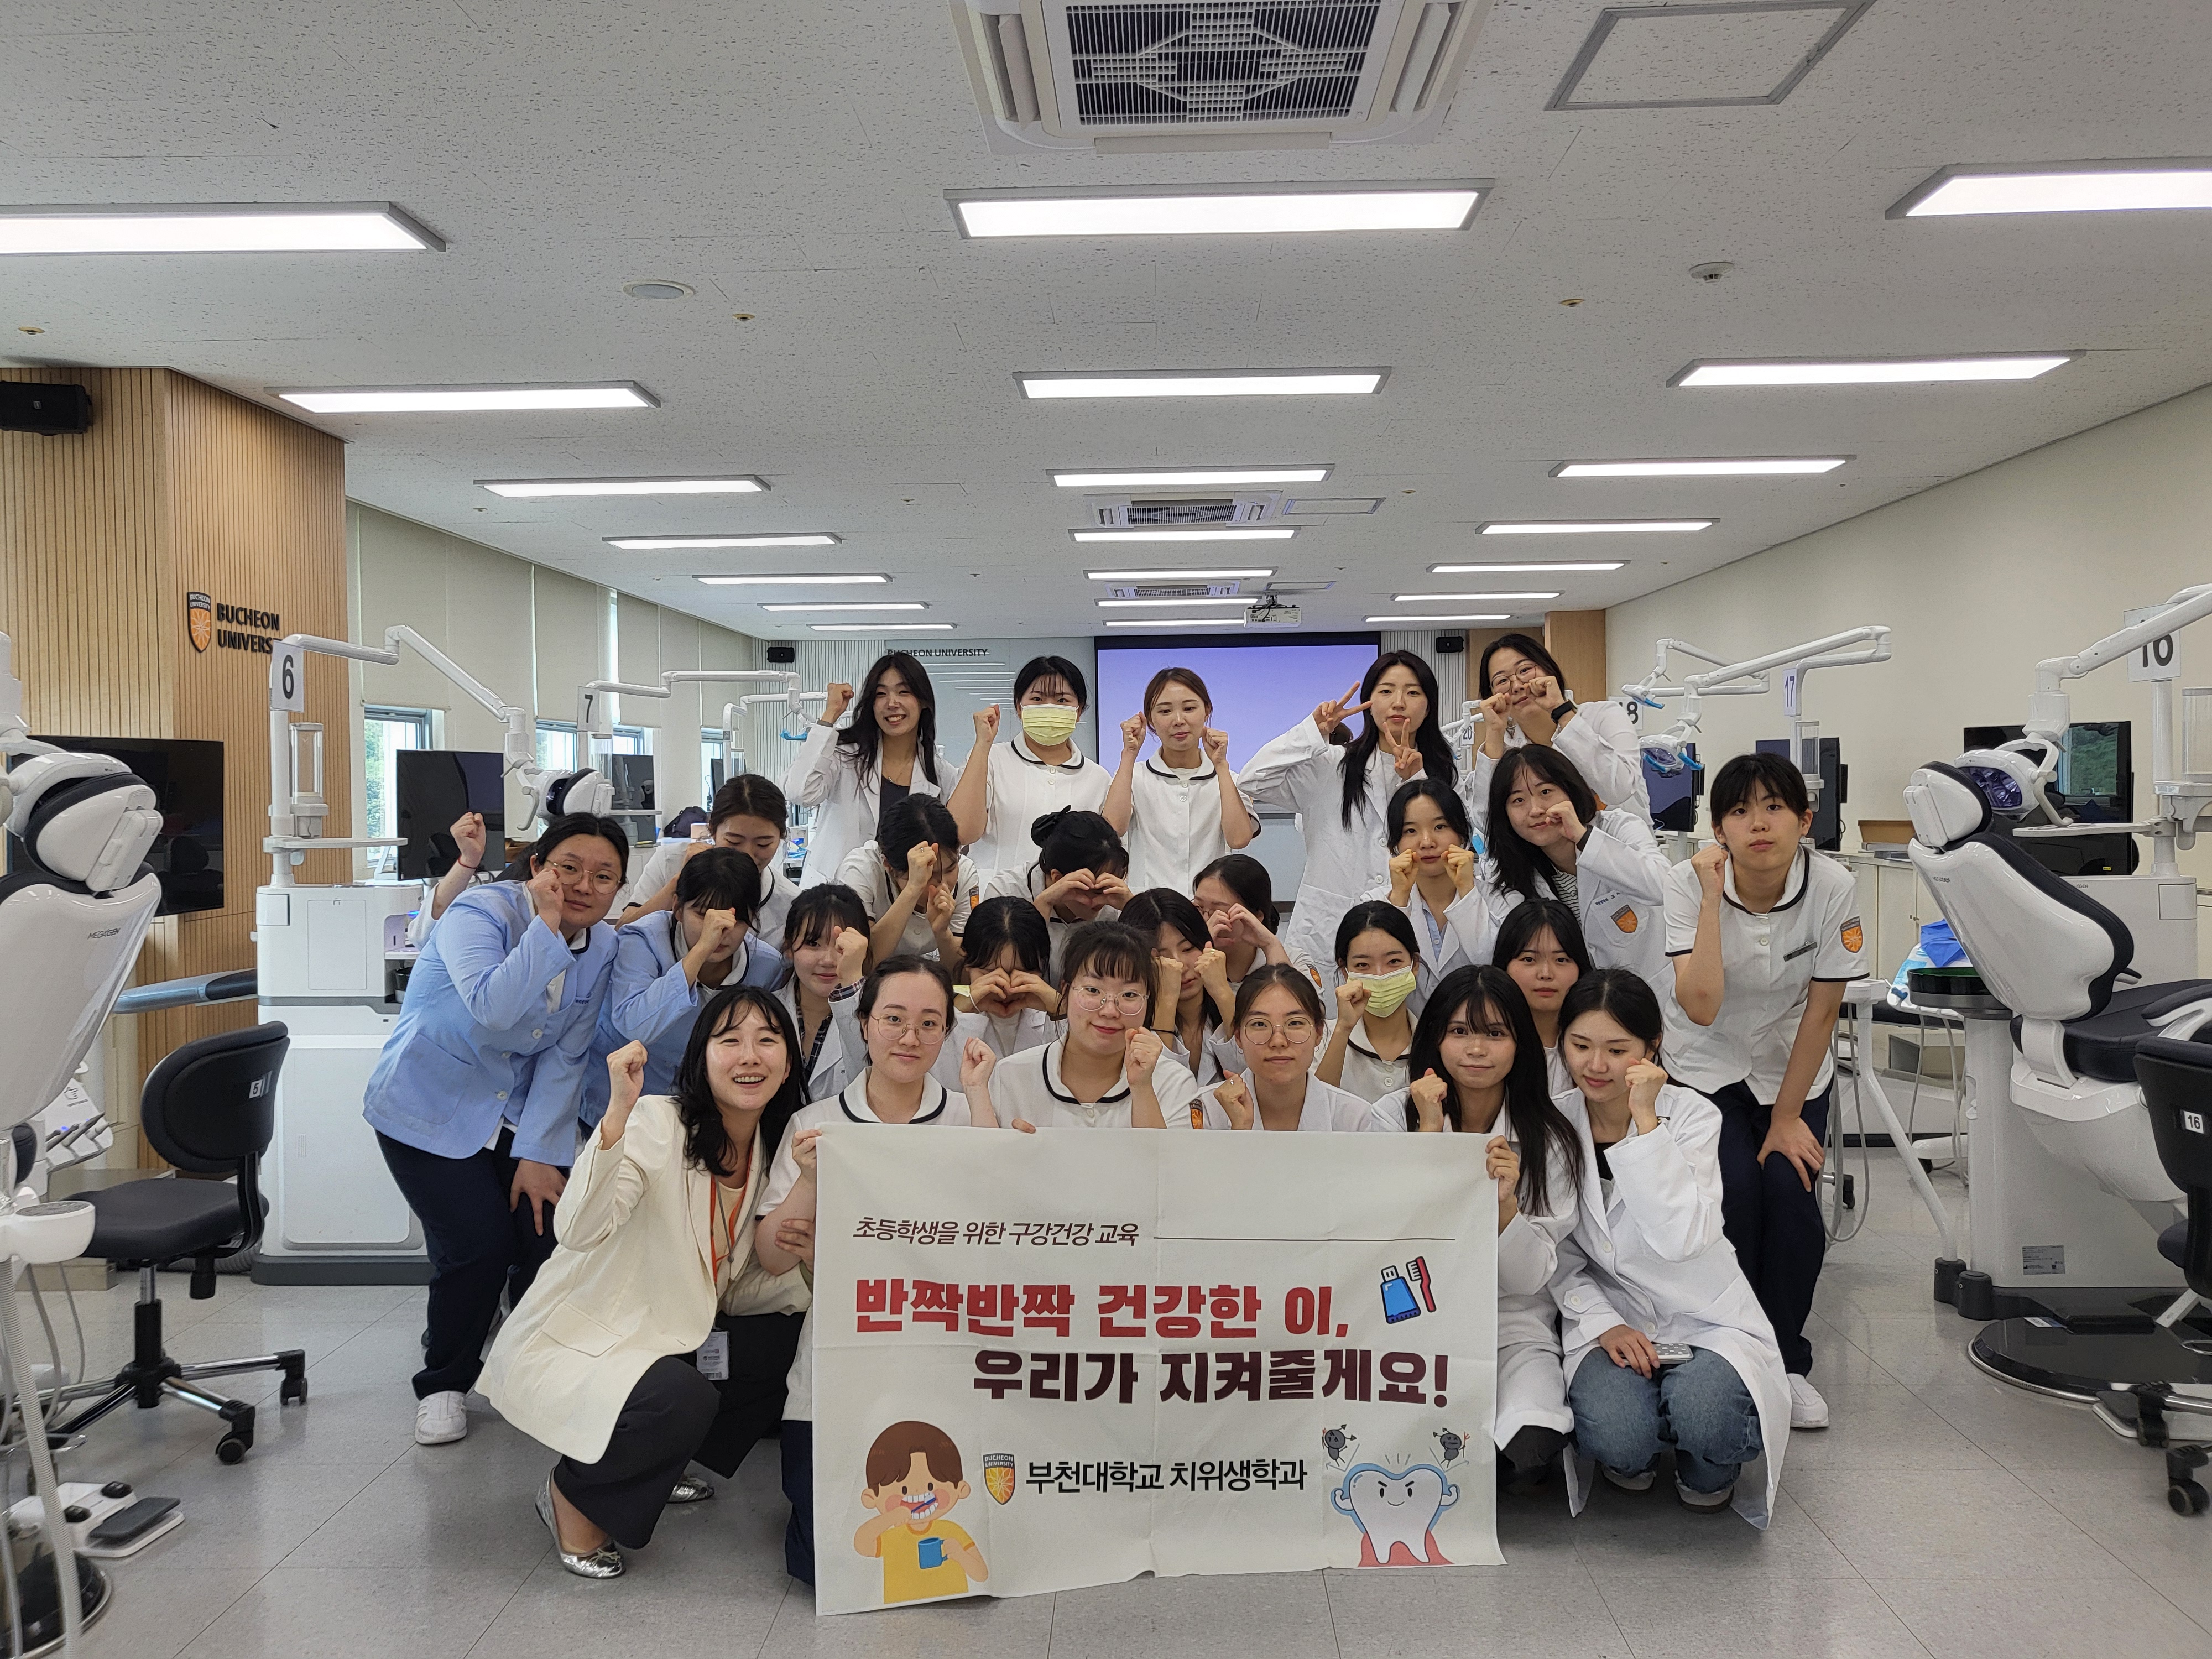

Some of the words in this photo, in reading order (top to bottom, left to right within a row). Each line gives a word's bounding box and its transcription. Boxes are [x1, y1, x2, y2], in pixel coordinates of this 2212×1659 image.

[217, 603, 280, 631] BUCHEON
[217, 629, 282, 654] UNIVERS
[282, 654, 294, 700] 6
[1785, 675, 1795, 707] 17
[585, 693, 593, 723] 7
[1618, 701, 1639, 724] 8
[253, 1082, 260, 1095] 5
[2188, 1114, 2201, 1130] 16
[853, 1217, 960, 1245] 초등학생을
[962, 1222, 1006, 1245] 위한
[1008, 1222, 1094, 1246] 구강건강
[1095, 1223, 1139, 1246] 교육
[856, 1279, 1076, 1337] 반짝반짝
[1098, 1284, 1262, 1339] 건강한
[1284, 1286, 1349, 1338] 이,
[974, 1350, 1139, 1404] 우리가
[1159, 1349, 1449, 1408] 지켜줄게요!
[1026, 1461, 1164, 1494] 부천대학교
[1169, 1458, 1308, 1492] 치위생학과
